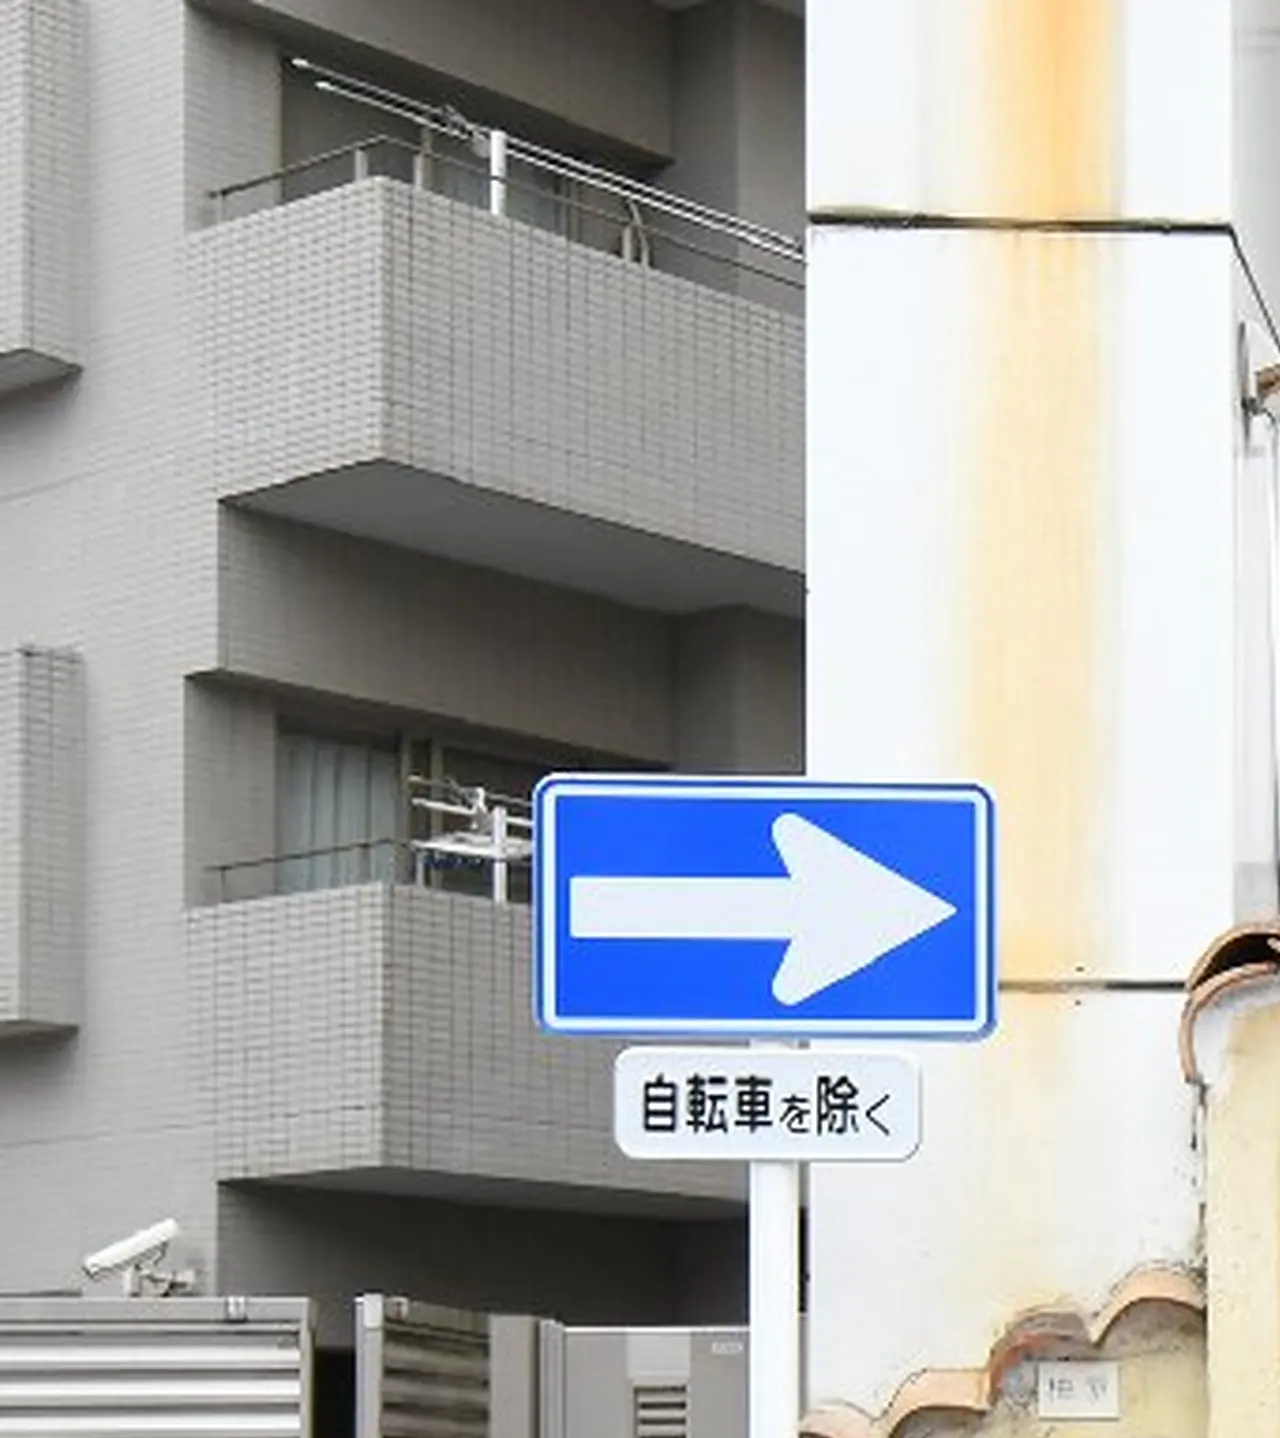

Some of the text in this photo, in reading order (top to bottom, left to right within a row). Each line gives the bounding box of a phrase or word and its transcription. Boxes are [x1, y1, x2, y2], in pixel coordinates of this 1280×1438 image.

[642, 1072, 892, 1137] 自転車を除く
